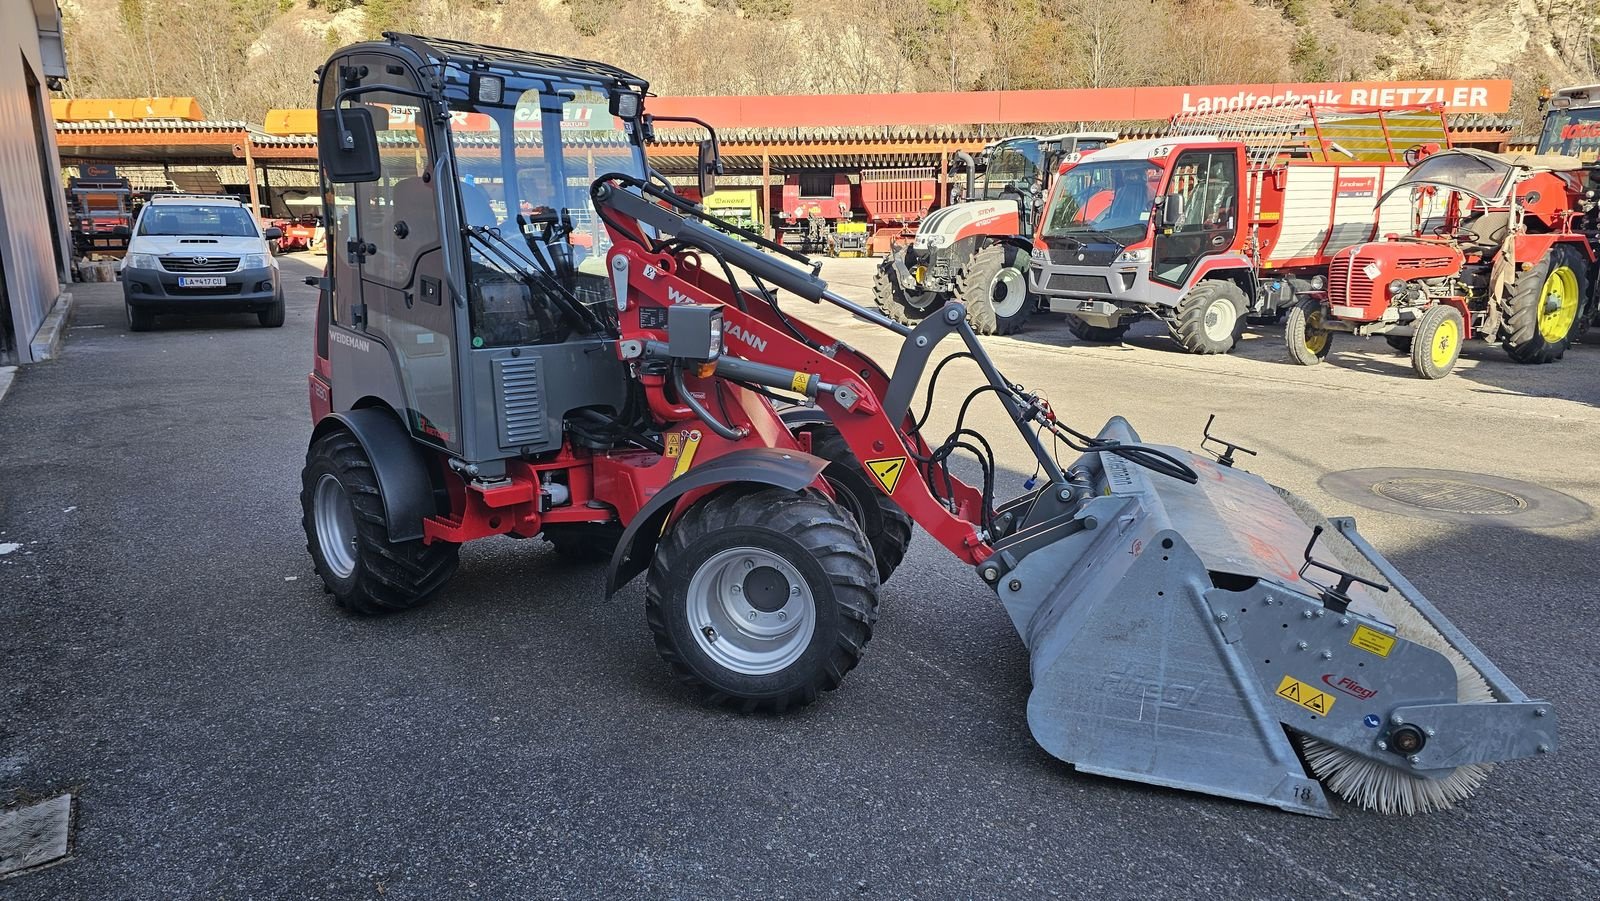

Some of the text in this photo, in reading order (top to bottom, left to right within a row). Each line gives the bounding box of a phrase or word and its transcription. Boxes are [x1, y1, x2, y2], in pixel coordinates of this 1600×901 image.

[1181, 87, 1488, 113] Landtechnik RIETZLER
[329, 330, 370, 353] WEIDEMANN
[1337, 677, 1379, 700] Fliegl
[1293, 784, 1311, 800] 18
